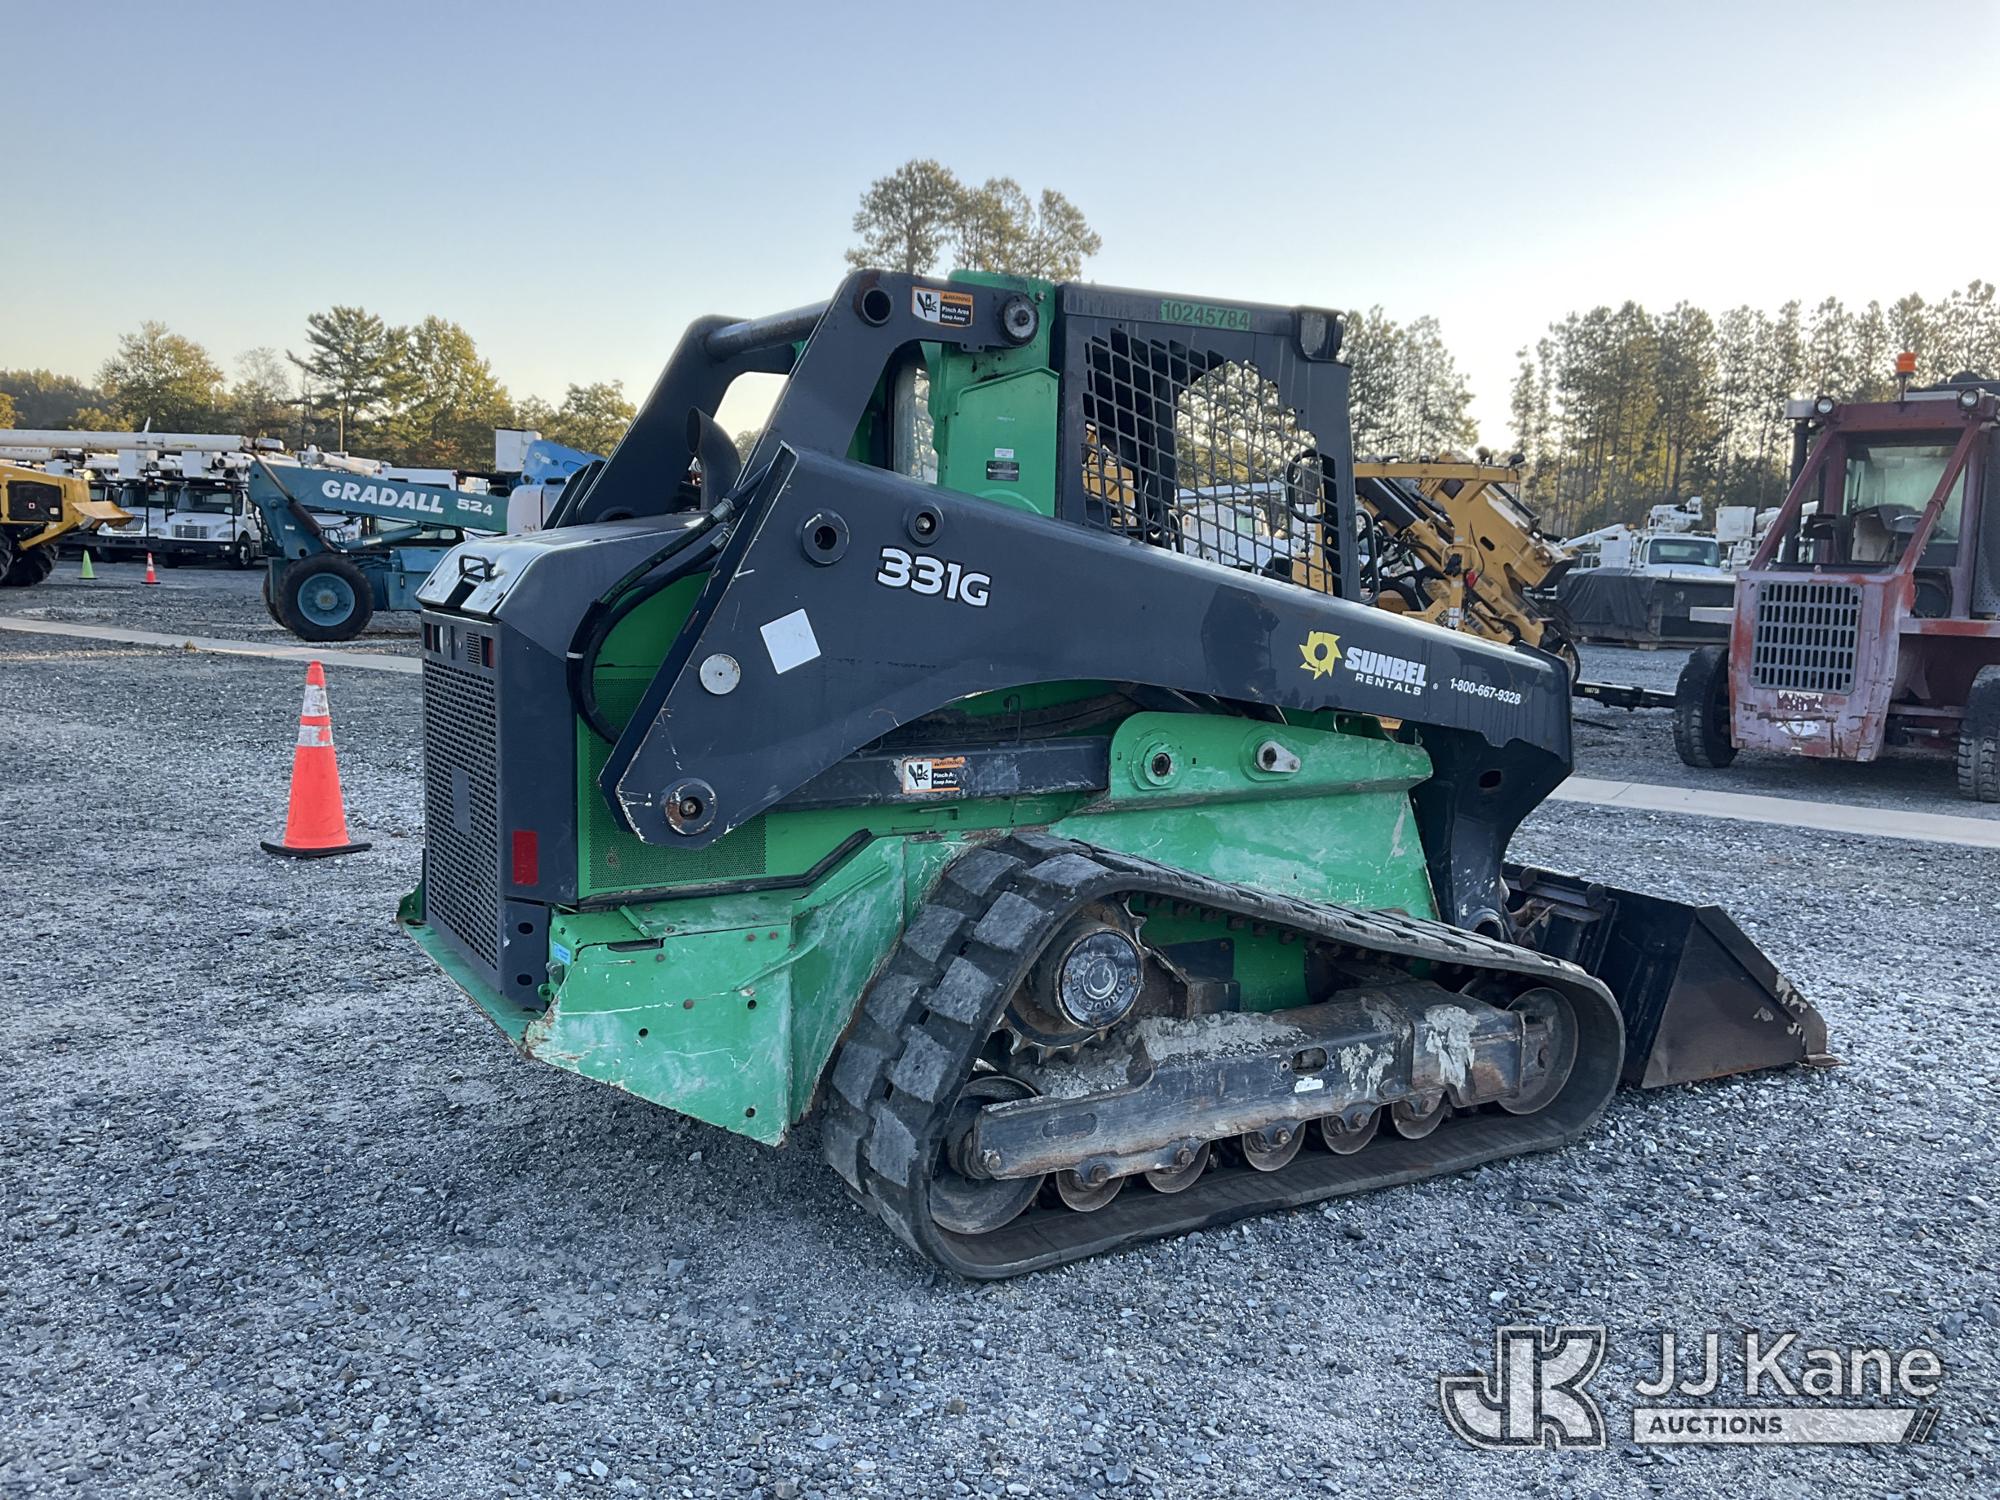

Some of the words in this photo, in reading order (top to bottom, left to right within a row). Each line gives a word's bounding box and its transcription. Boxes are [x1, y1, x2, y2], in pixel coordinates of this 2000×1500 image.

[941, 305, 957, 313] Pinch
[957, 307, 970, 315] Area
[1162, 301, 1249, 329] 10245784
[322, 479, 444, 513] GRADALL
[456, 498, 494, 516] 524
[877, 548, 990, 606] 331G
[1344, 646, 1427, 687] SUNBEL
[1355, 672, 1422, 696] RENTALS
[1449, 677, 1521, 705] 1-800-667-9328
